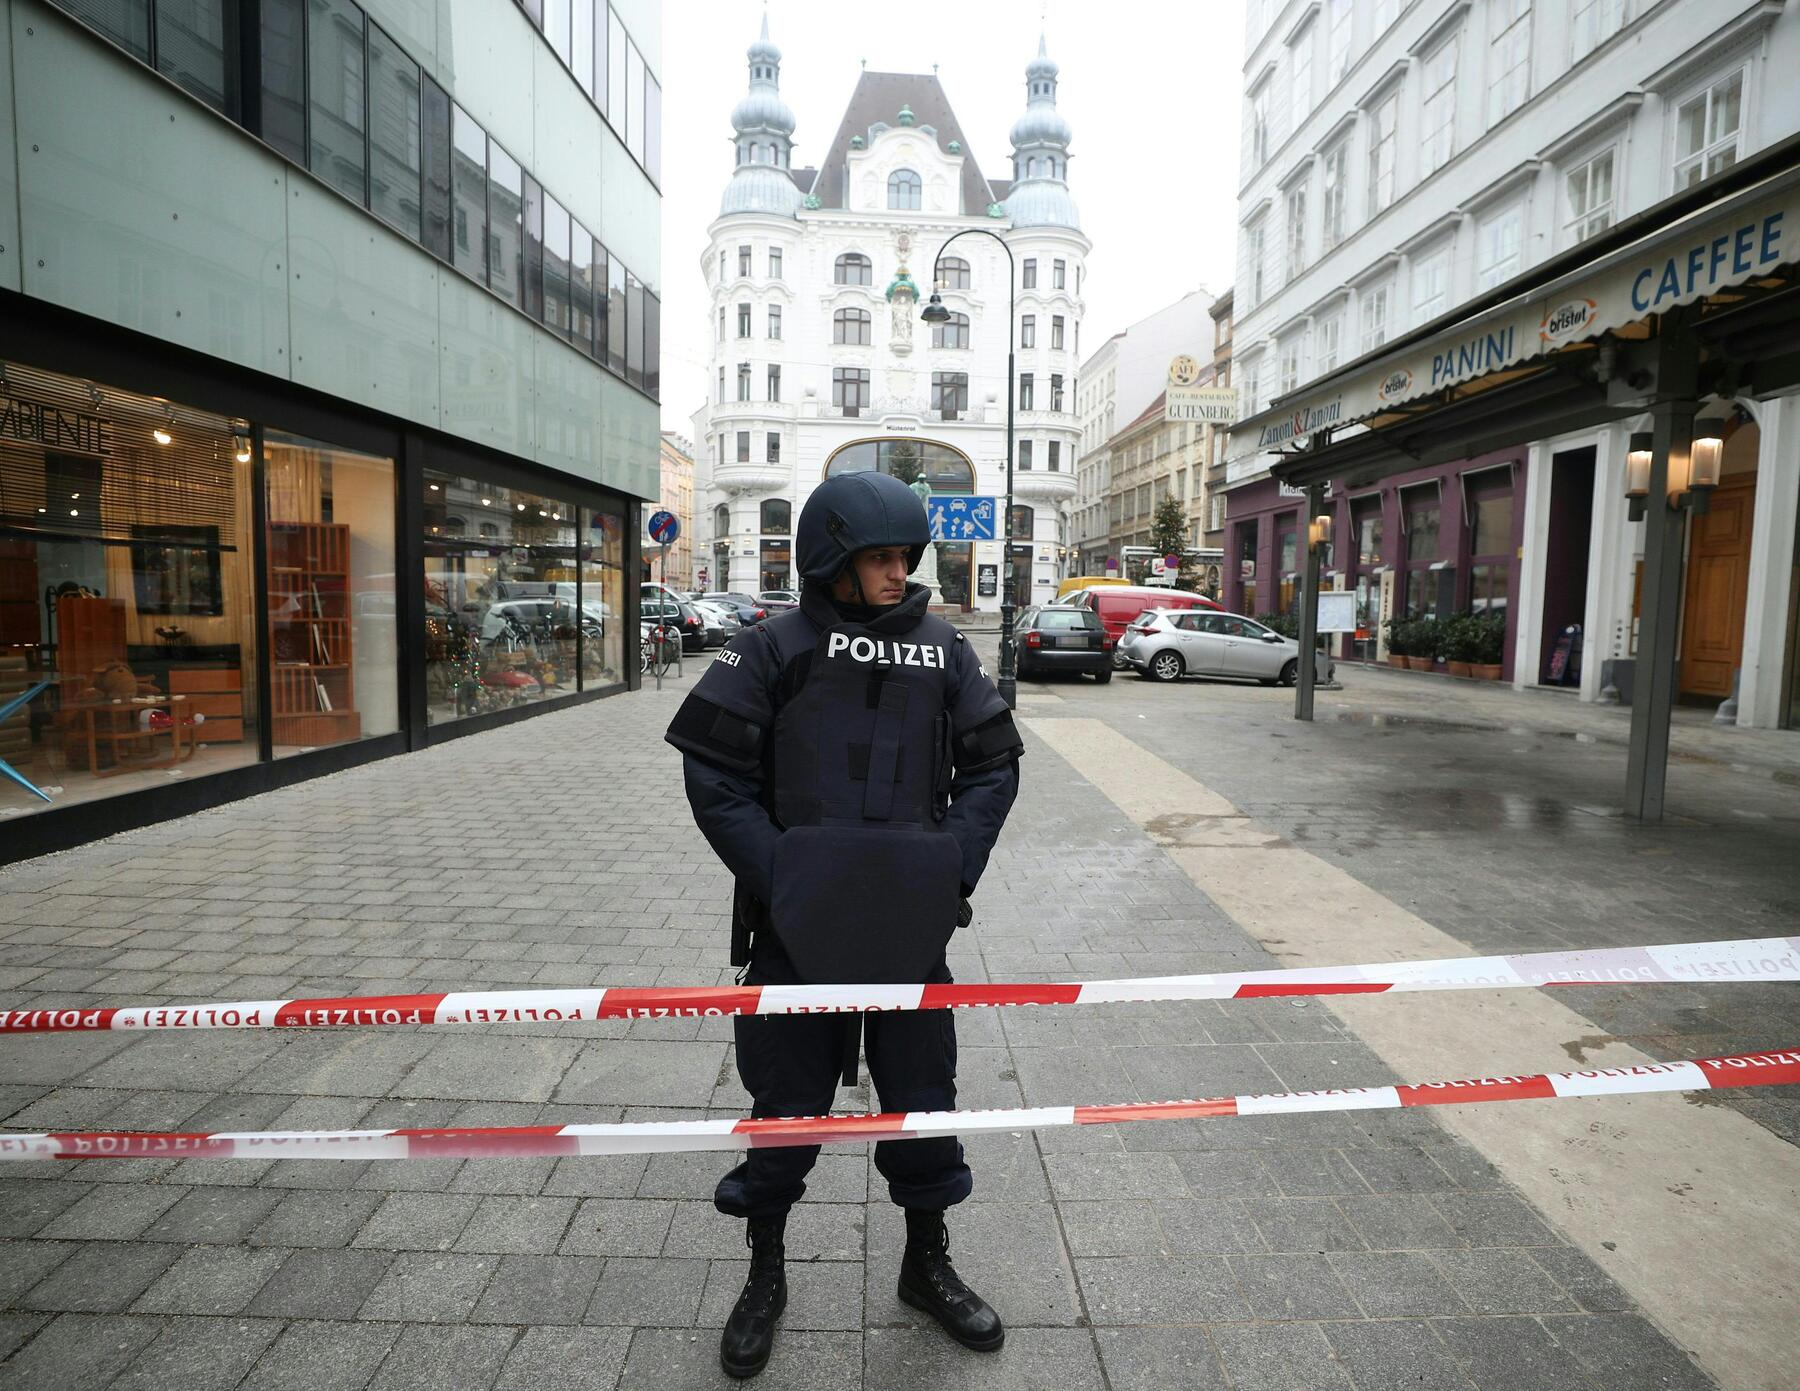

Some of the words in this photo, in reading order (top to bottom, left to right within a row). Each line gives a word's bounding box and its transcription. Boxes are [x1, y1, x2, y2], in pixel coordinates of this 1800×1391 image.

[1631, 212, 1784, 312] CAFFEE
[1432, 325, 1514, 386] PANINI
[1169, 404, 1234, 420] GUTENBERG
[827, 631, 945, 669] POLIZEI
[143, 1010, 261, 1027] POLIZEI
[304, 1008, 420, 1025] POLIZEI
[1559, 1063, 1674, 1080] POLIZEI
